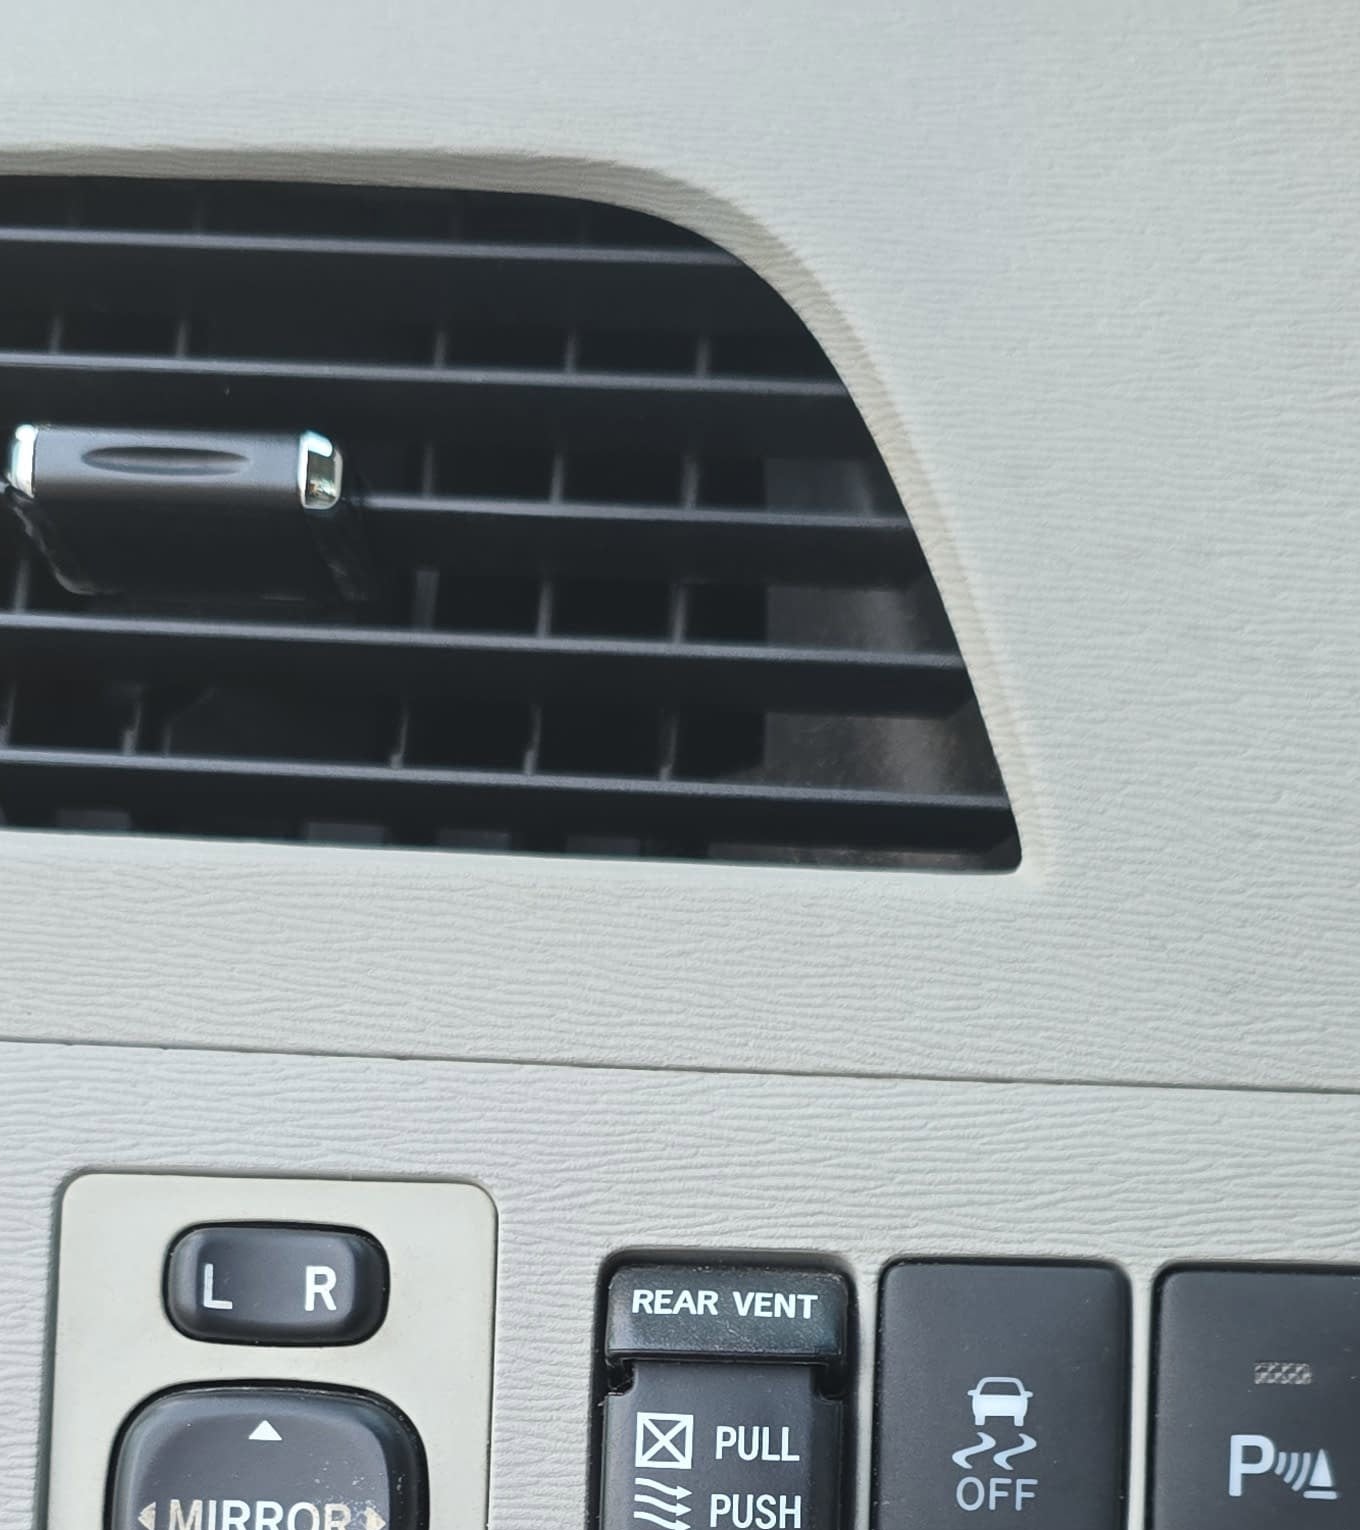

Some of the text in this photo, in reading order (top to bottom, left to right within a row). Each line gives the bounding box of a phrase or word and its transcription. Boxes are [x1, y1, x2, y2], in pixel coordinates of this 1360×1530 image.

[202, 1263, 337, 1312] L R
[632, 1290, 819, 1319] REAR VENT
[716, 1426, 800, 1462] PULL
[1229, 1435, 1274, 1497] P
[710, 1494, 802, 1530] PUSH
[957, 1477, 1038, 1511] OFF
